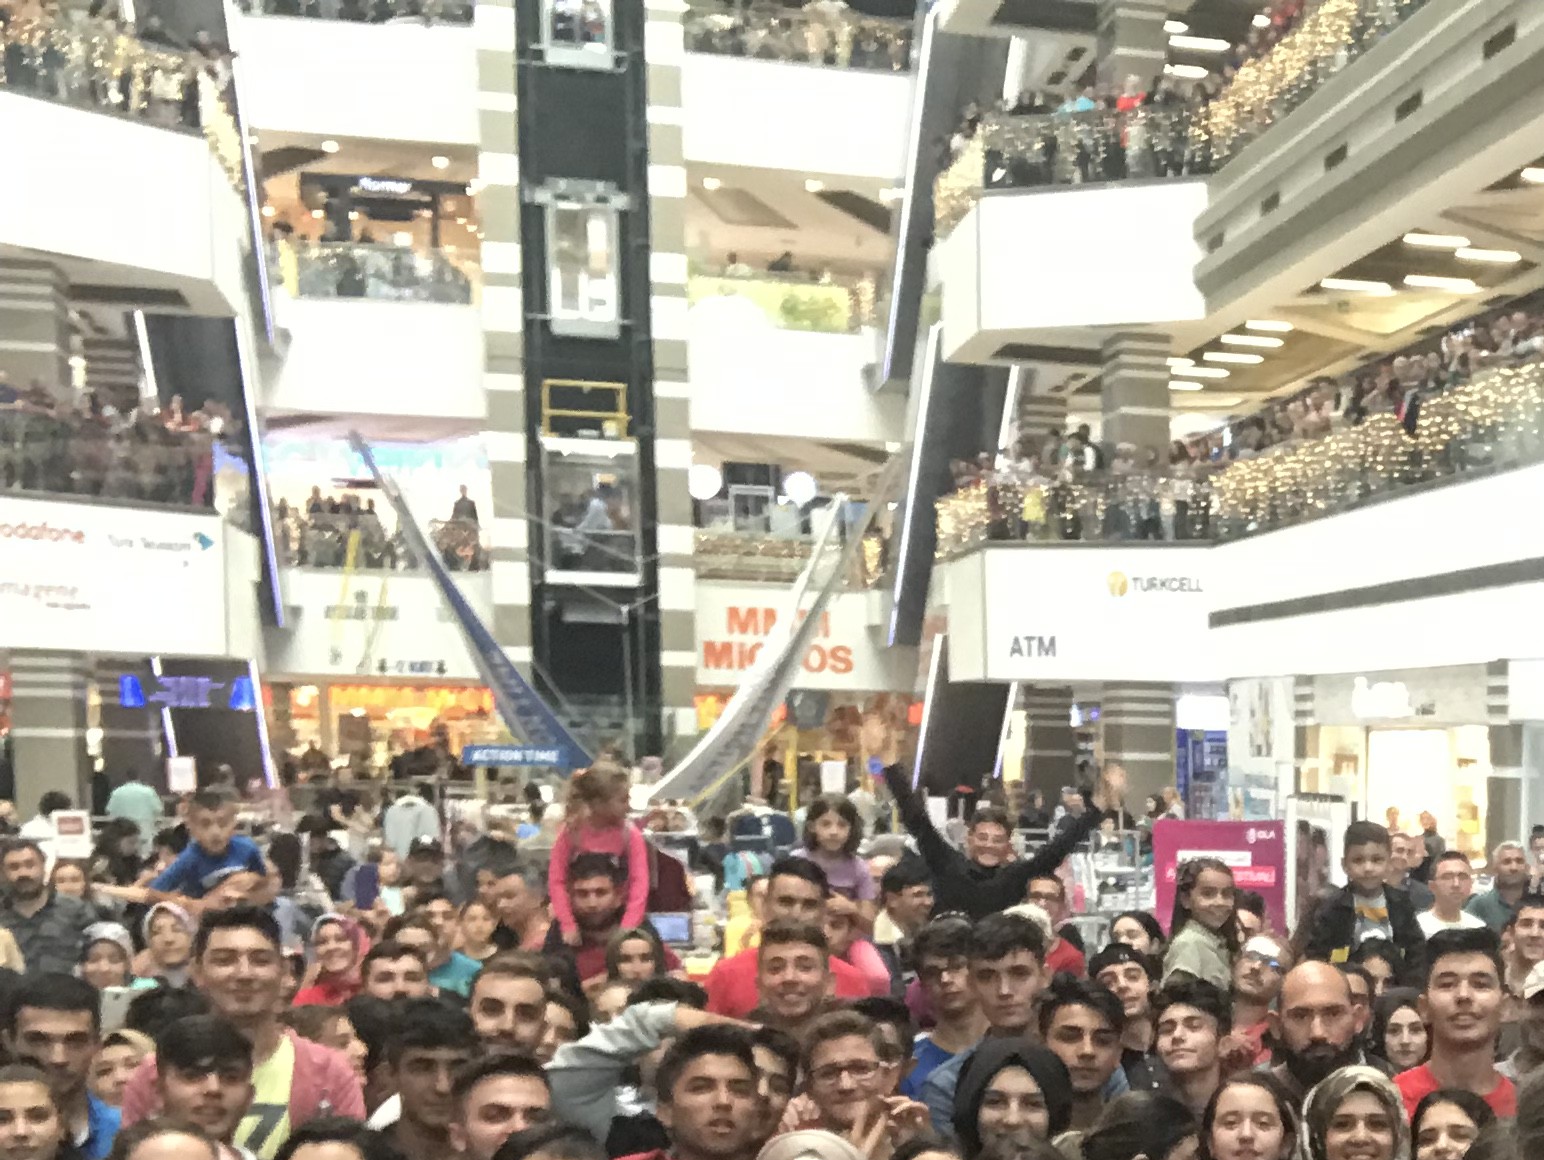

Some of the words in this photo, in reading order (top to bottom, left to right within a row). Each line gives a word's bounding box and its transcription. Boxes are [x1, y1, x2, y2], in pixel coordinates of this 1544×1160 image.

[0, 522, 85, 544] odafone
[1132, 577, 1203, 592] TURKCELL
[1009, 635, 1057, 657] ATM
